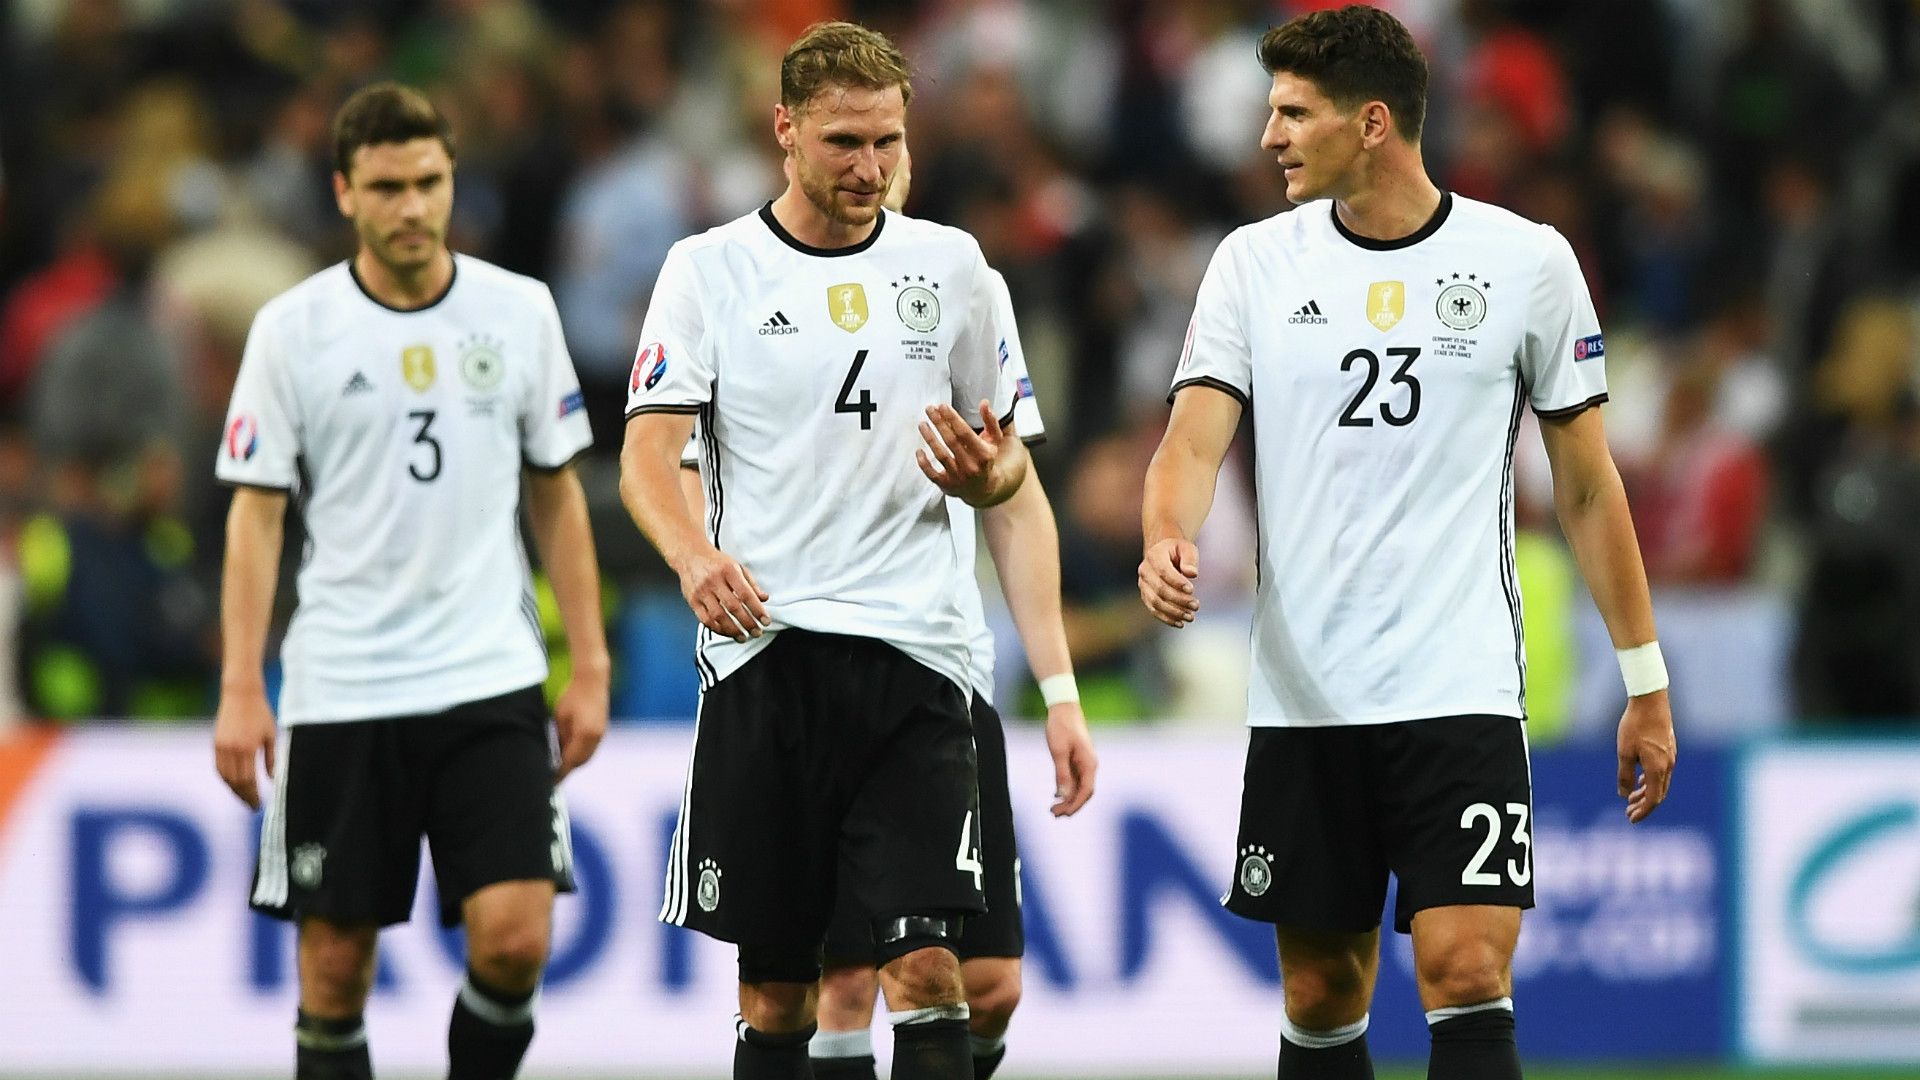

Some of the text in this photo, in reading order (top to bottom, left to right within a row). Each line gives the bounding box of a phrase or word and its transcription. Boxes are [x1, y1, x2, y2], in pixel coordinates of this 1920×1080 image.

[759, 326, 799, 335] adidas
[1288, 315, 1328, 324] adidas
[834, 349, 878, 430] 4
[1338, 347, 1422, 427] 23
[408, 411, 442, 482] 3
[956, 810, 983, 891] 4
[1460, 802, 1531, 887] 23
